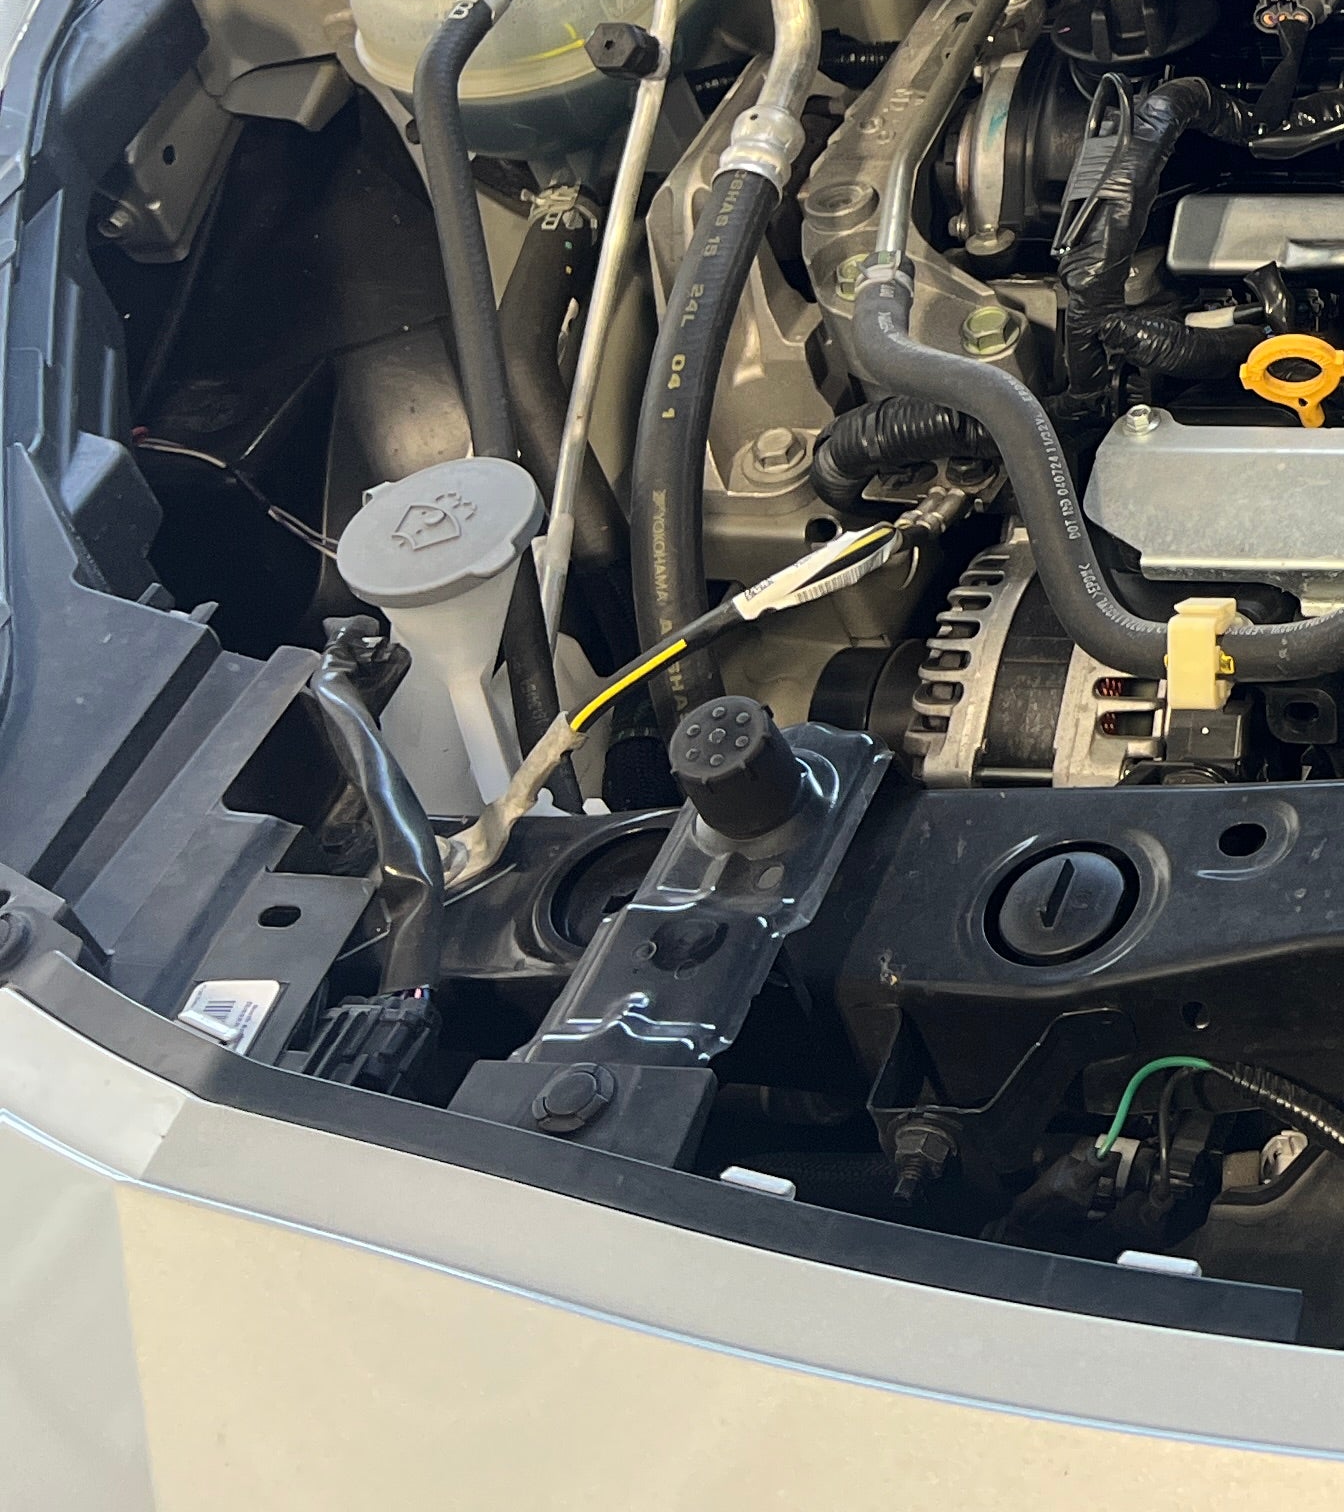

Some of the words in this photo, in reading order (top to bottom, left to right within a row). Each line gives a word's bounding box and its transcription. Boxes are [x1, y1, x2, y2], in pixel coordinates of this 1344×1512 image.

[679, 285, 706, 328] 24L
[665, 353, 688, 391] 04
[653, 510, 669, 602] YOKOHAMA
